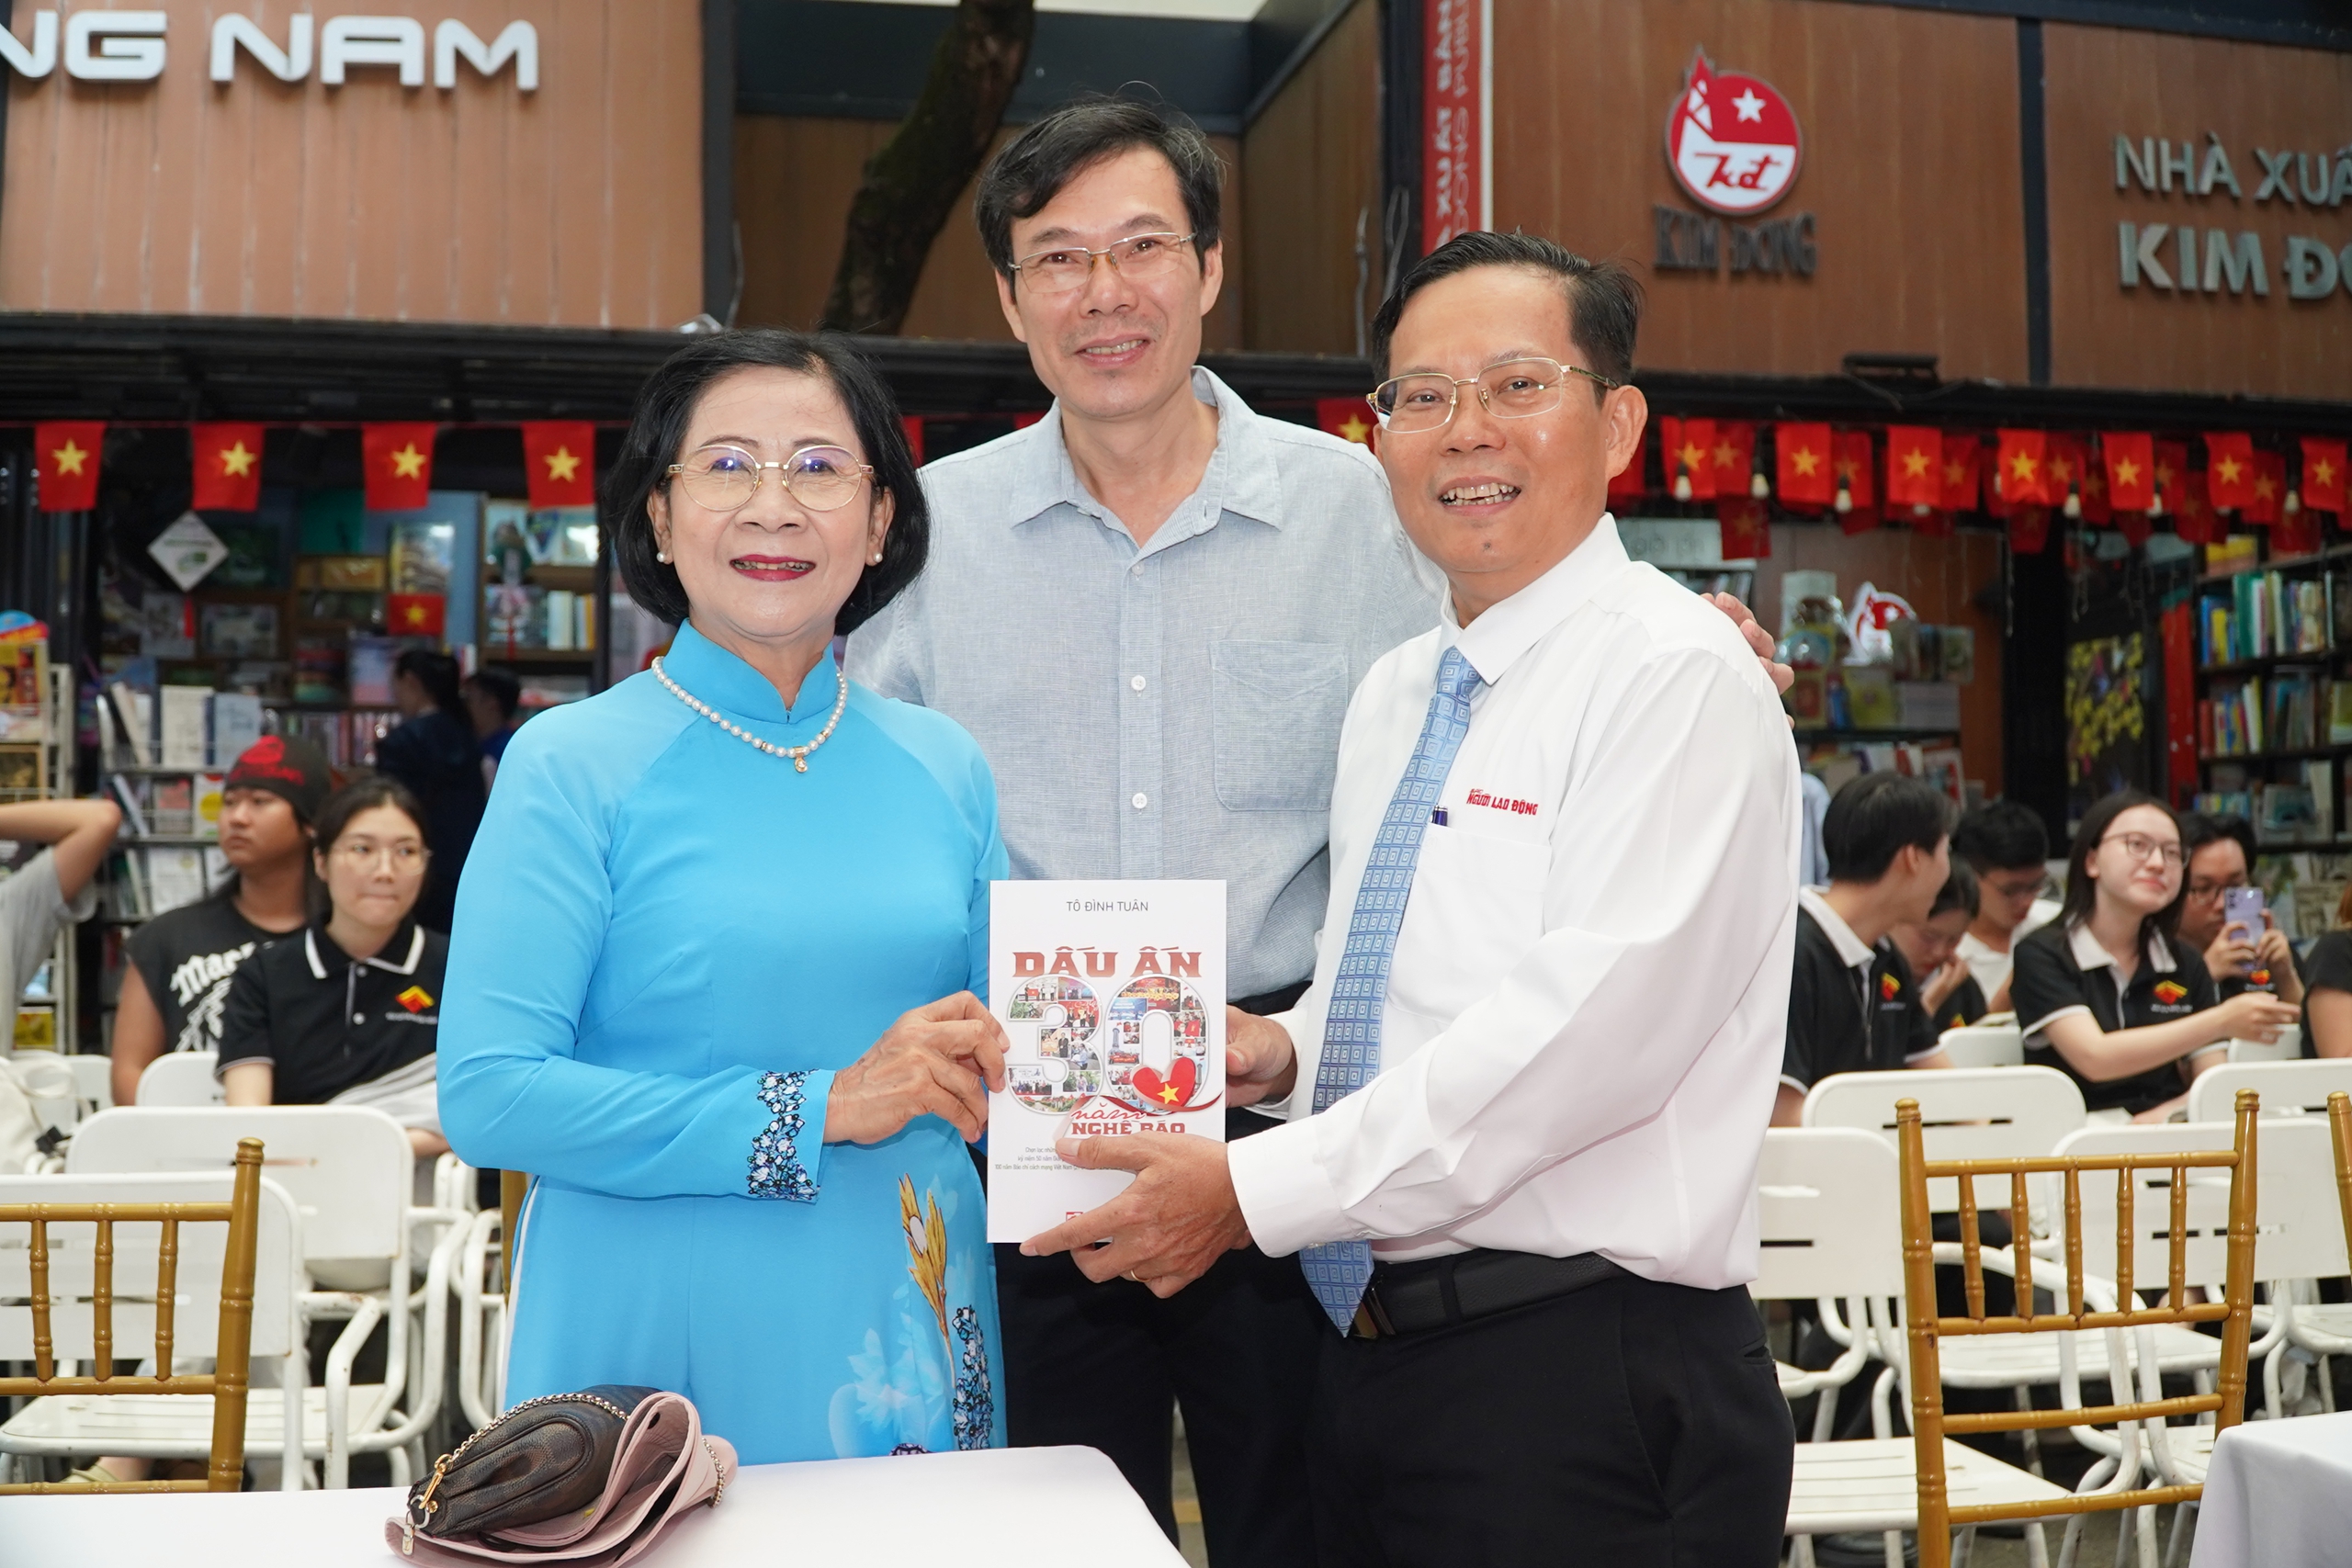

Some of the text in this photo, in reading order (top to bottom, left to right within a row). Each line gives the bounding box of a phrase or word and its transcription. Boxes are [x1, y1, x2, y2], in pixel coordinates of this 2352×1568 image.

[210, 13, 539, 91] NAM
[2116, 131, 2242, 197] NHÀ
[1655, 205, 1720, 267] KIM
[2119, 220, 2352, 299] KIM Đ
[1491, 796, 1510, 810] LAO
[1511, 798, 1538, 816] ĐỘNG
[1066, 898, 1148, 912] TÔ ĐÌNH TUÂN
[1012, 946, 1202, 977] DẤU ẤN
[1006, 974, 1210, 1115] 30
[1070, 1102, 1146, 1120] năm
